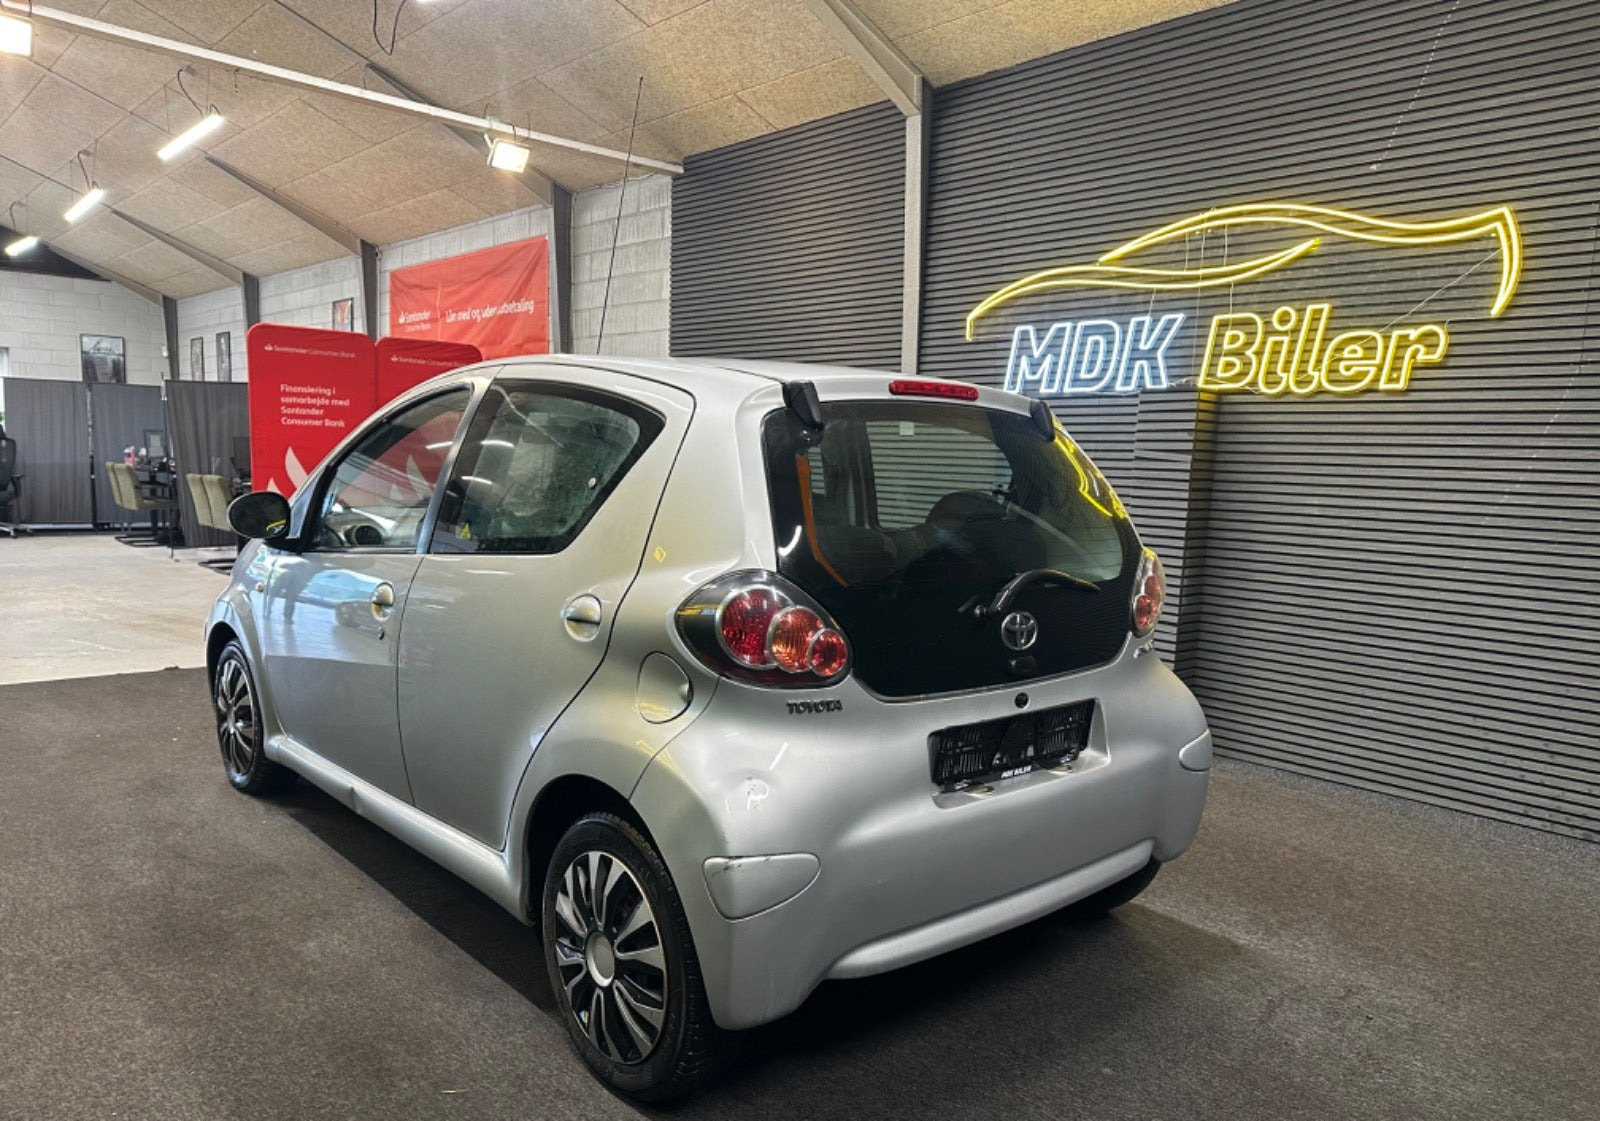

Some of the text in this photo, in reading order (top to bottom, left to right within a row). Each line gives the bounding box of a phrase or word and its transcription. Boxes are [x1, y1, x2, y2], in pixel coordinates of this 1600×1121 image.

[457, 308, 470, 321] med
[471, 309, 481, 323] og
[274, 344, 307, 354] Santander
[308, 348, 339, 357] Consumer
[1003, 303, 1449, 395] MDK Biler
[397, 356, 426, 365] Santander
[280, 384, 331, 396] Finansiering
[280, 396, 350, 407] samarbejde med
[280, 406, 324, 415] Santander
[281, 417, 346, 428] Consumer Bank
[786, 699, 843, 714] TOYOTA
